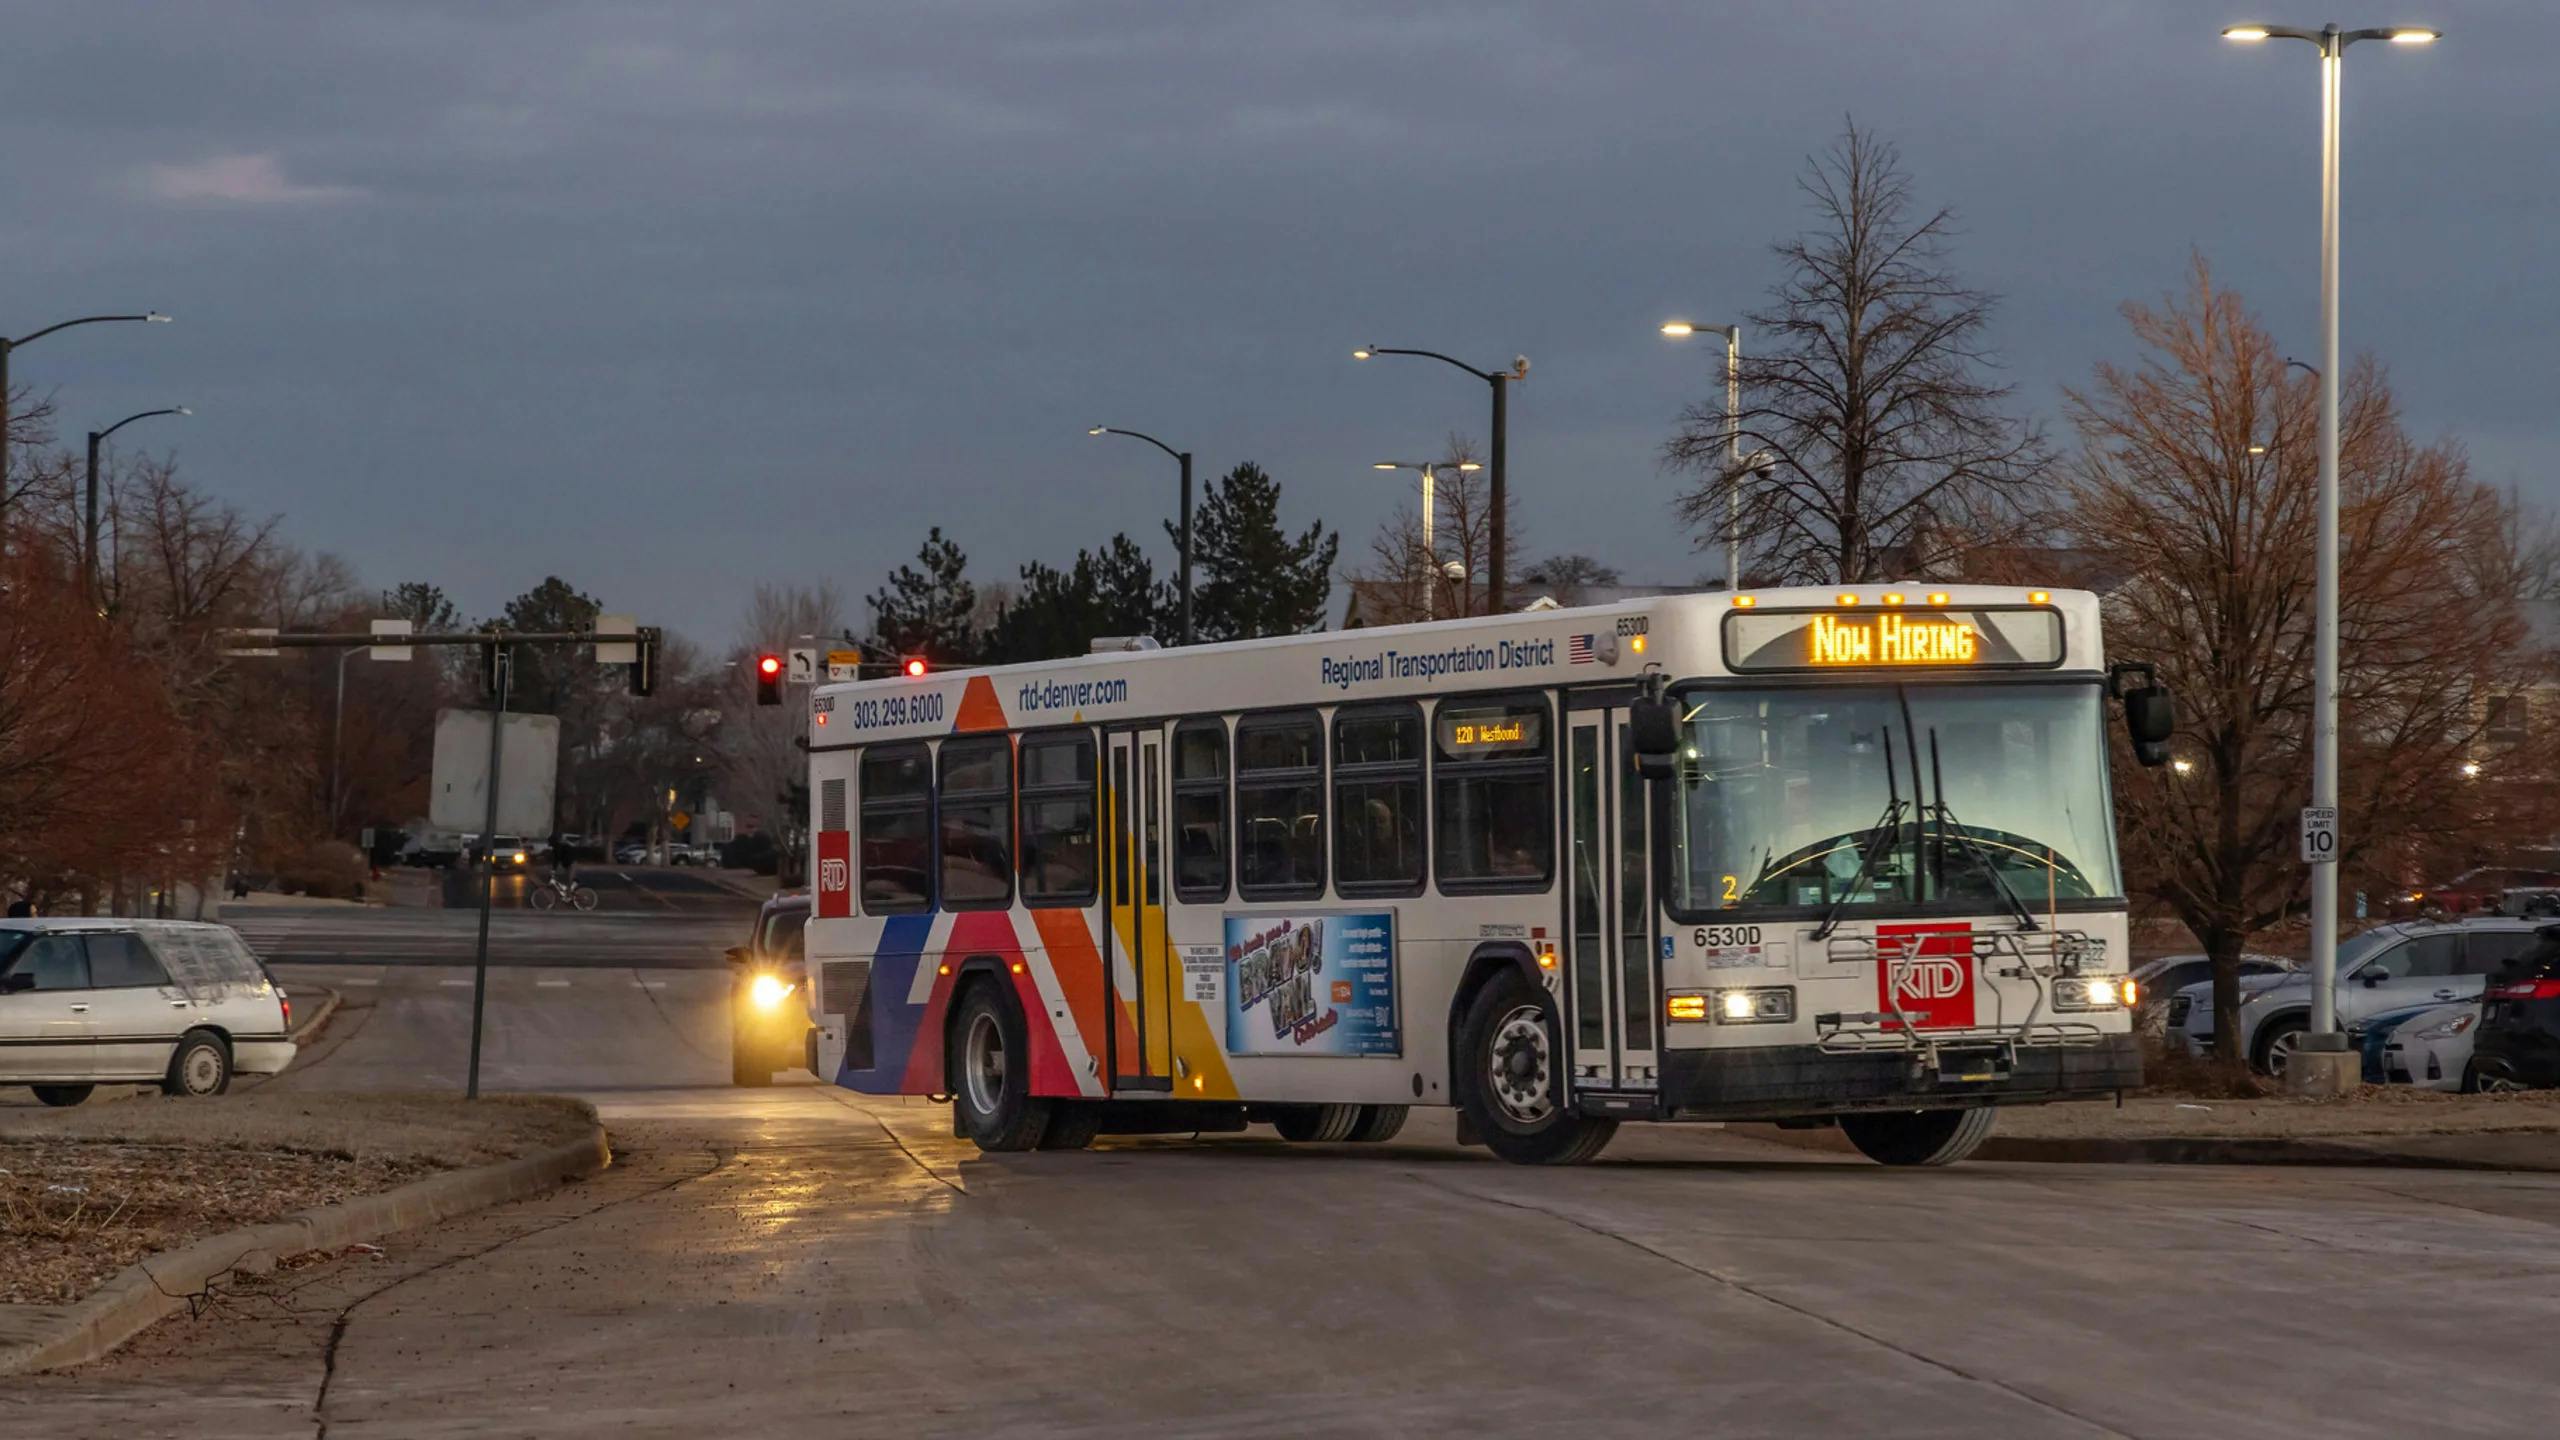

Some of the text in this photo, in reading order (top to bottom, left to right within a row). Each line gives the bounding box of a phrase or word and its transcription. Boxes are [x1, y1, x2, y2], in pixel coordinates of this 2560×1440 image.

[1617, 616, 1649, 637] 6530D
[1321, 638, 1554, 690] Regional Transportation District
[814, 696, 835, 714] 6530D
[1019, 678, 1127, 712] rtd-denver.com
[854, 693, 944, 729] 303.299.6000
[1480, 721, 1519, 743] Westbound
[2304, 810, 2334, 819] SPEED
[2307, 820, 2331, 829] LIMIT
[2305, 830, 2334, 852] 10
[821, 858, 847, 892] RTD
[1722, 875, 1738, 900] 2
[1694, 926, 1761, 947] 6530D
[1886, 957, 1965, 999] RTD
